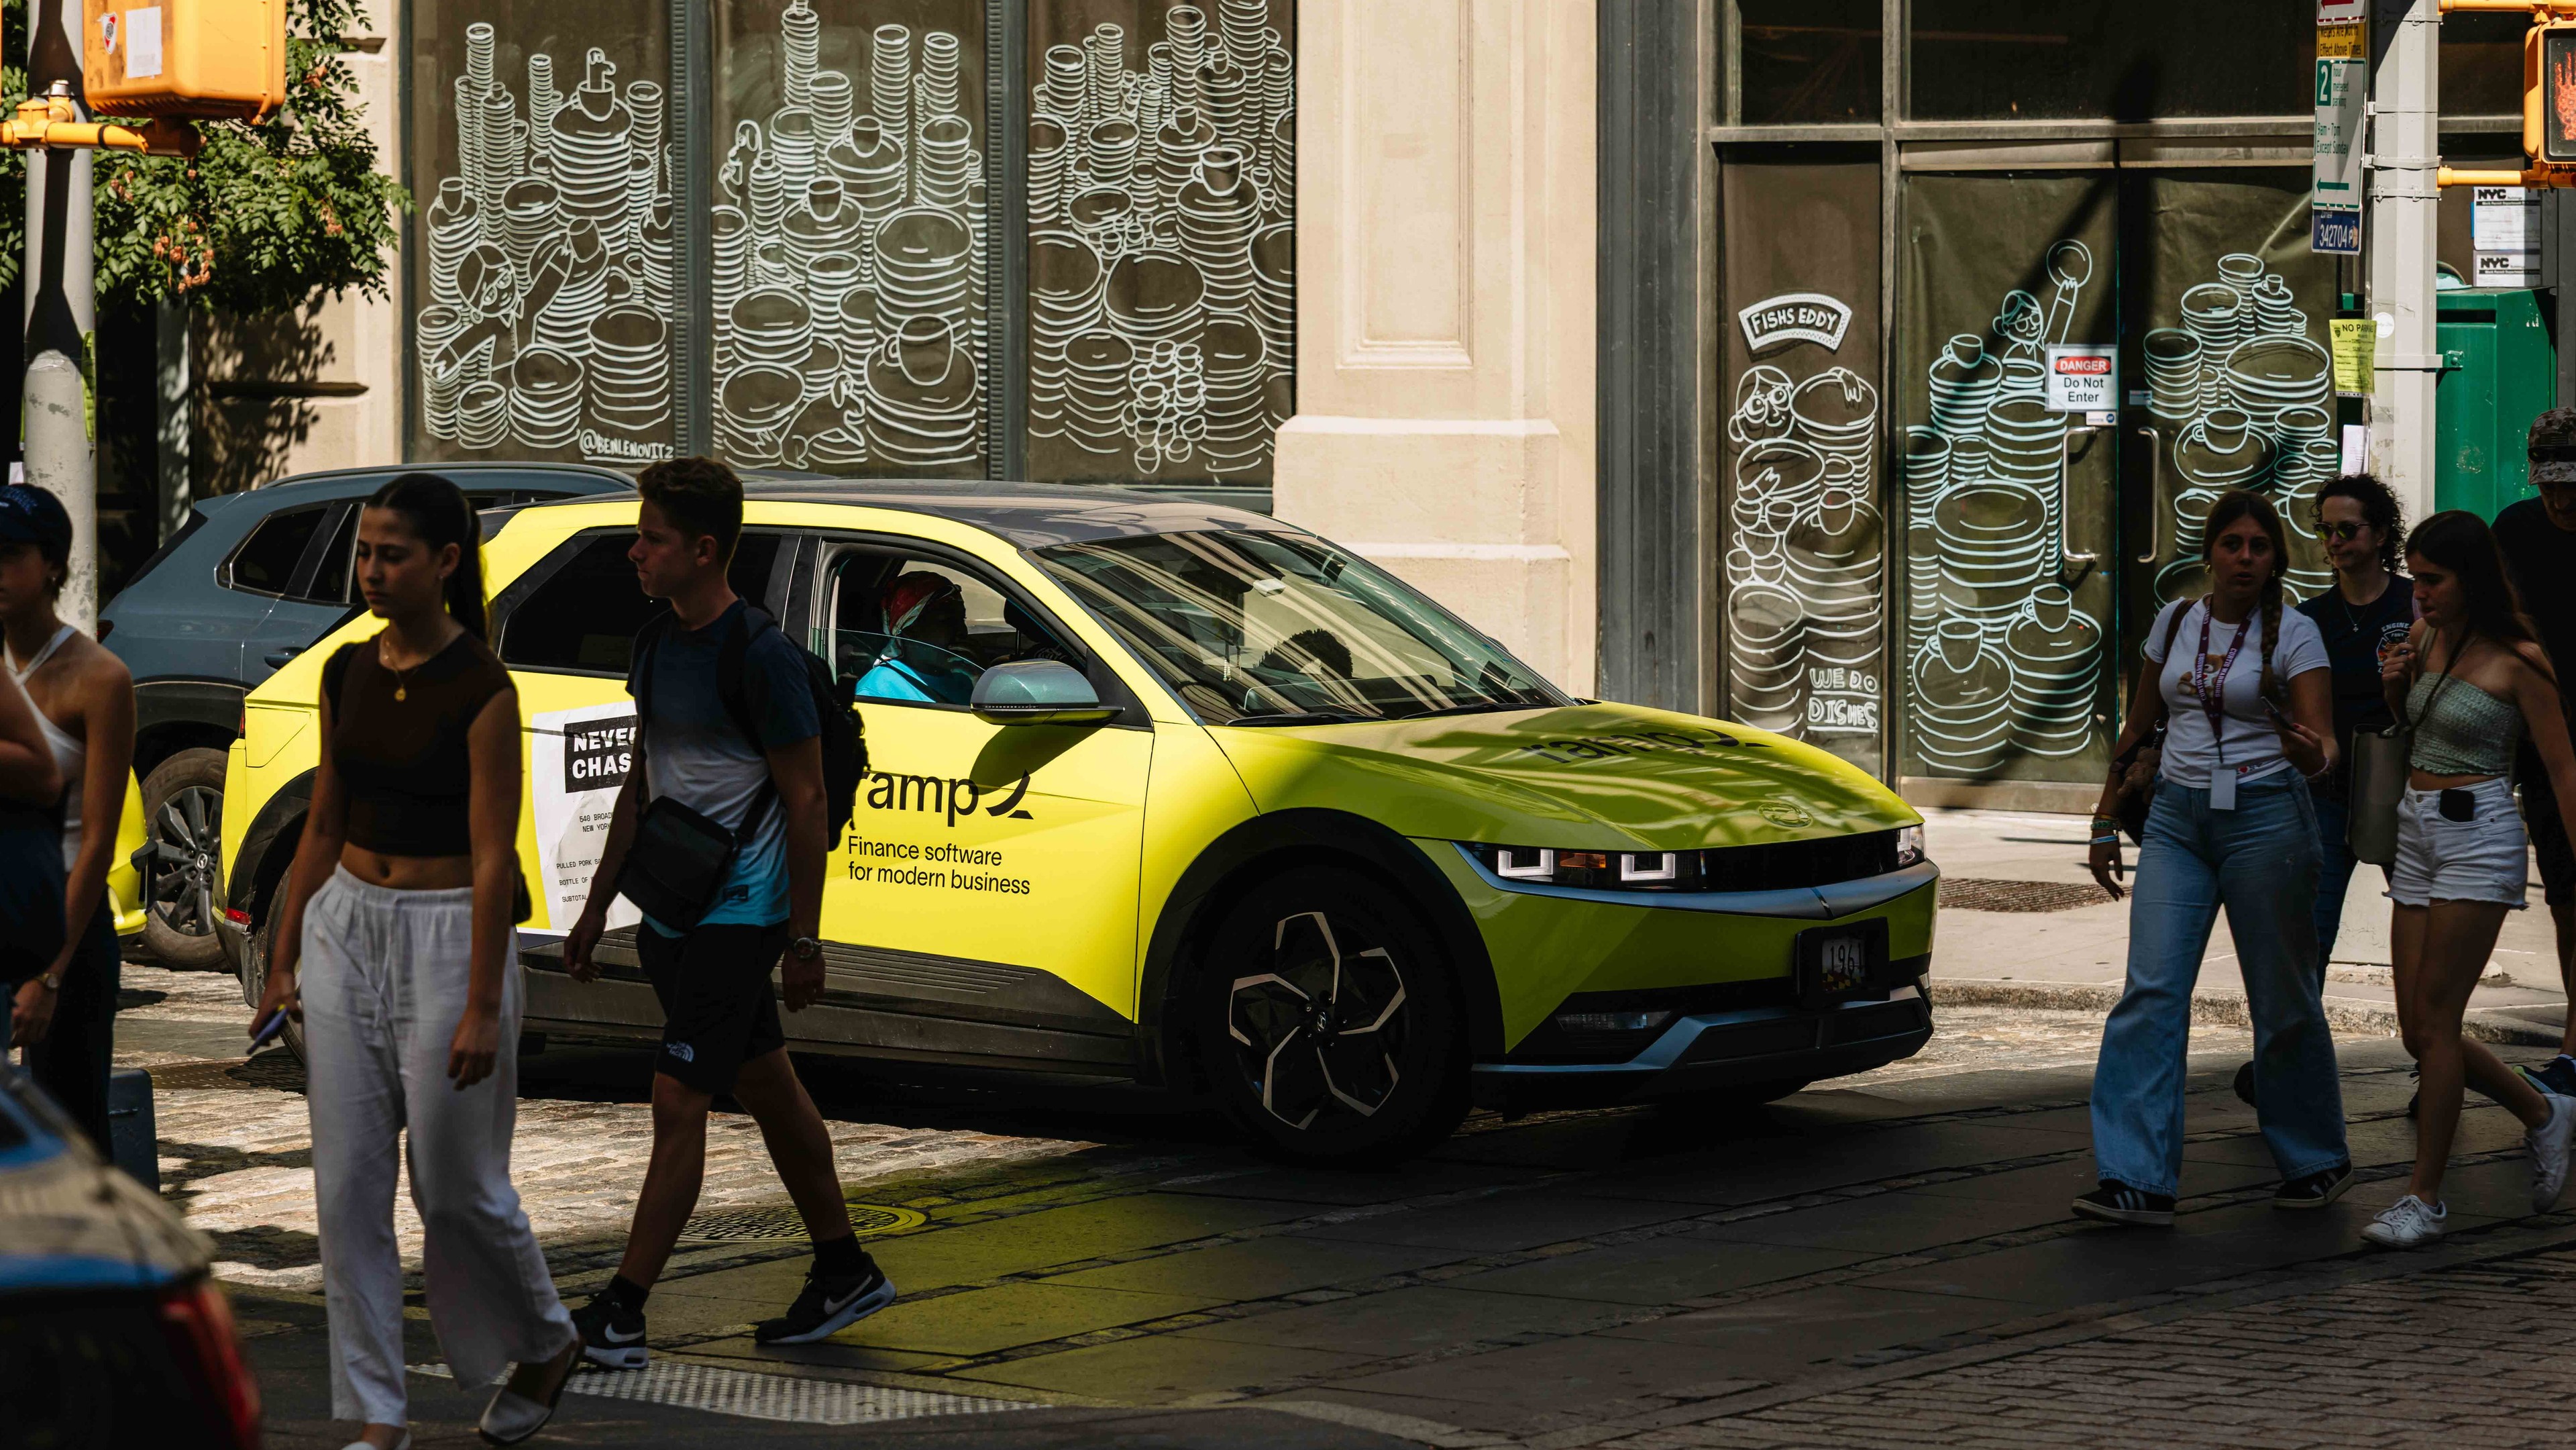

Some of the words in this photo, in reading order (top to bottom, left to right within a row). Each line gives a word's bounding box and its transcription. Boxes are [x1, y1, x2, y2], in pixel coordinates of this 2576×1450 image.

[2320, 43, 2332, 56] Effect
[2334, 43, 2347, 56] Above
[2349, 42, 2361, 55] Times
[2333, 66, 2342, 76] hour
[2320, 64, 2328, 101] 2
[2333, 81, 2349, 91] metered
[2332, 98, 2347, 109] parking
[2318, 122, 2326, 136] 9am
[2331, 123, 2341, 138] 7pm
[2316, 140, 2332, 156] Except
[2332, 140, 2349, 158] Sunday
[2477, 189, 2506, 199] NYC
[2319, 223, 2347, 248] 342704
[2480, 258, 2509, 268] NYC
[1751, 309, 1795, 334] FISHS
[1798, 307, 1838, 331] EDDY
[2342, 324, 2354, 332] NO
[2060, 360, 2107, 371] DANGER
[2063, 377, 2080, 388] Do
[2084, 377, 2104, 388] Not
[2068, 391, 2099, 402] Enter
[579, 428, 674, 460] @BENLENOVITZ
[2223, 648, 2238, 668] CURTIS
[1809, 668, 1845, 688] WE
[1807, 697, 1878, 729] DISHES
[594, 812, 613, 821] BROAD
[848, 835, 919, 860] Finance
[924, 843, 1002, 866] software
[556, 861, 576, 869] PULLED
[559, 878, 579, 886] BOTTLE
[849, 861, 873, 881] for
[877, 866, 945, 887] modern
[951, 869, 1030, 895] business
[561, 894, 588, 902] SUBTOTAL
